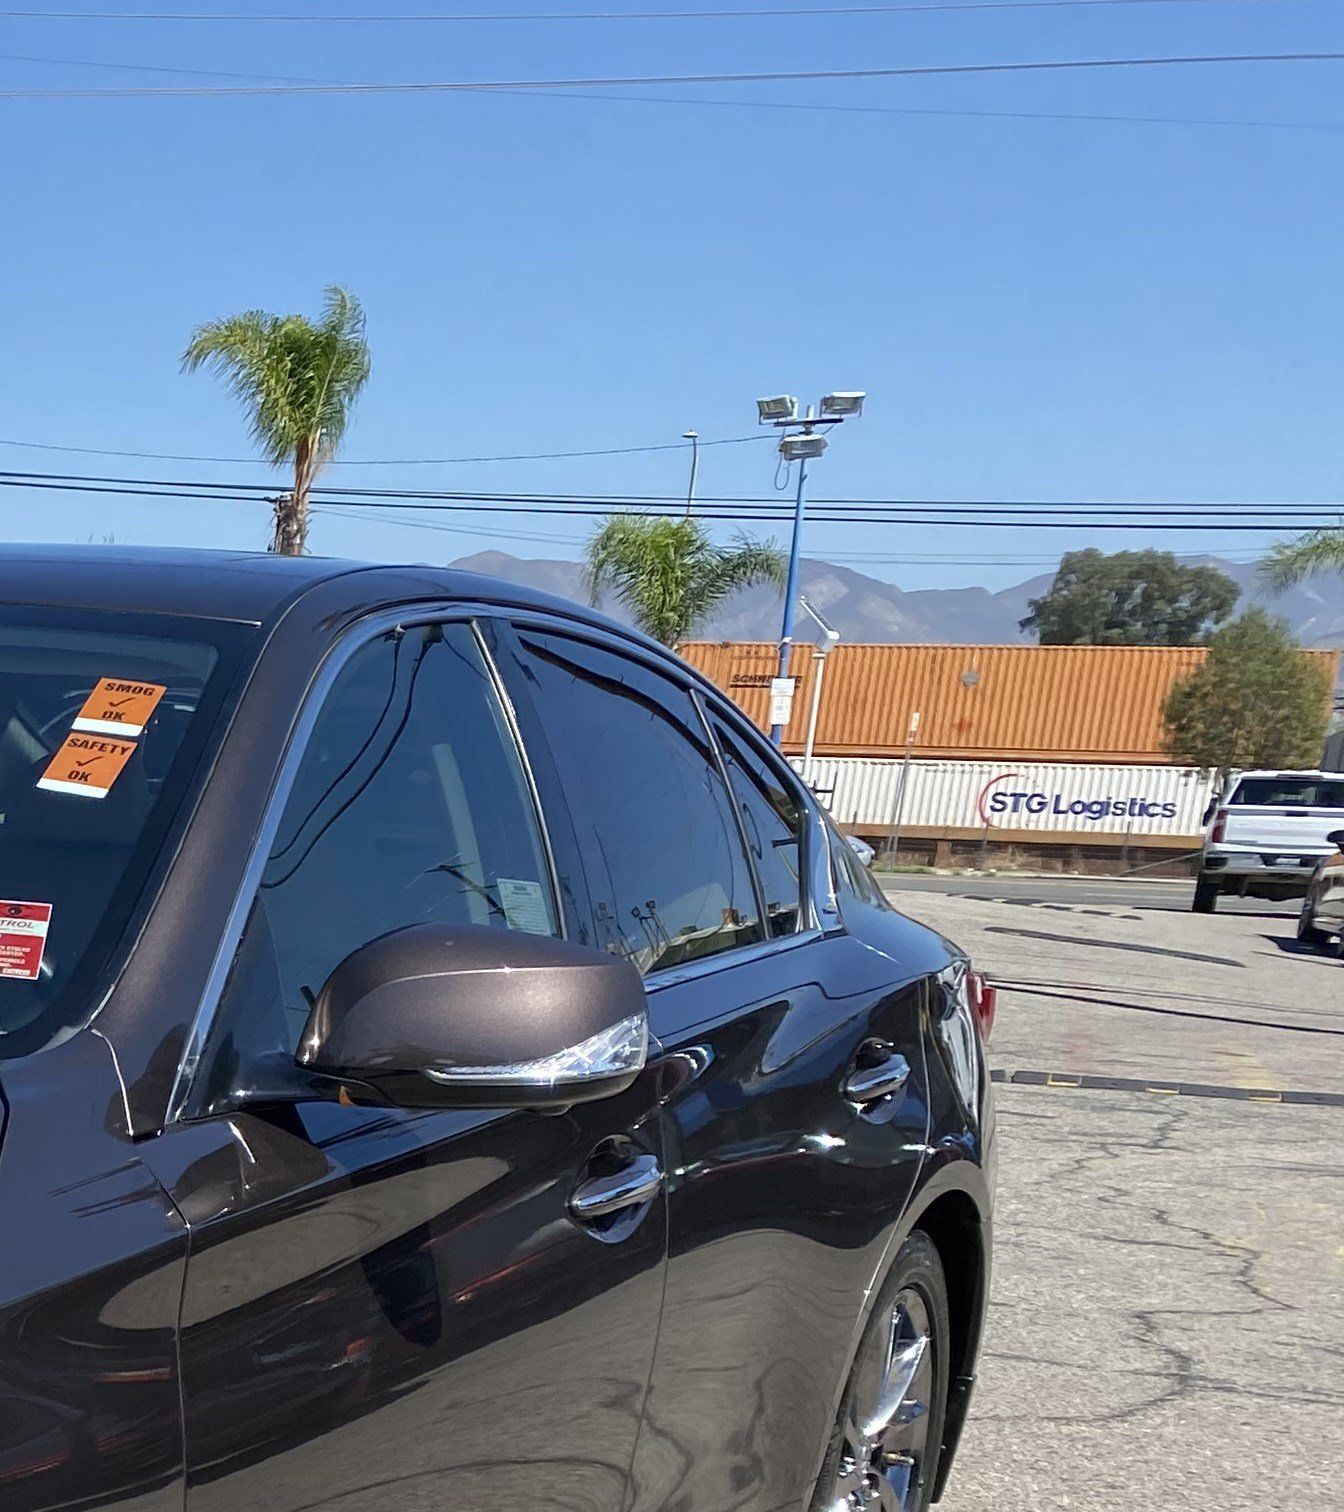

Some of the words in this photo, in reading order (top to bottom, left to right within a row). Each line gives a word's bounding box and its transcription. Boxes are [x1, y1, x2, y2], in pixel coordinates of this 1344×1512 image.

[104, 682, 156, 696] SMOG
[101, 710, 126, 721] OK
[66, 737, 132, 756] SAFETY
[67, 770, 92, 783] OK
[989, 792, 1048, 814] STG
[1052, 793, 1177, 821] Logistics
